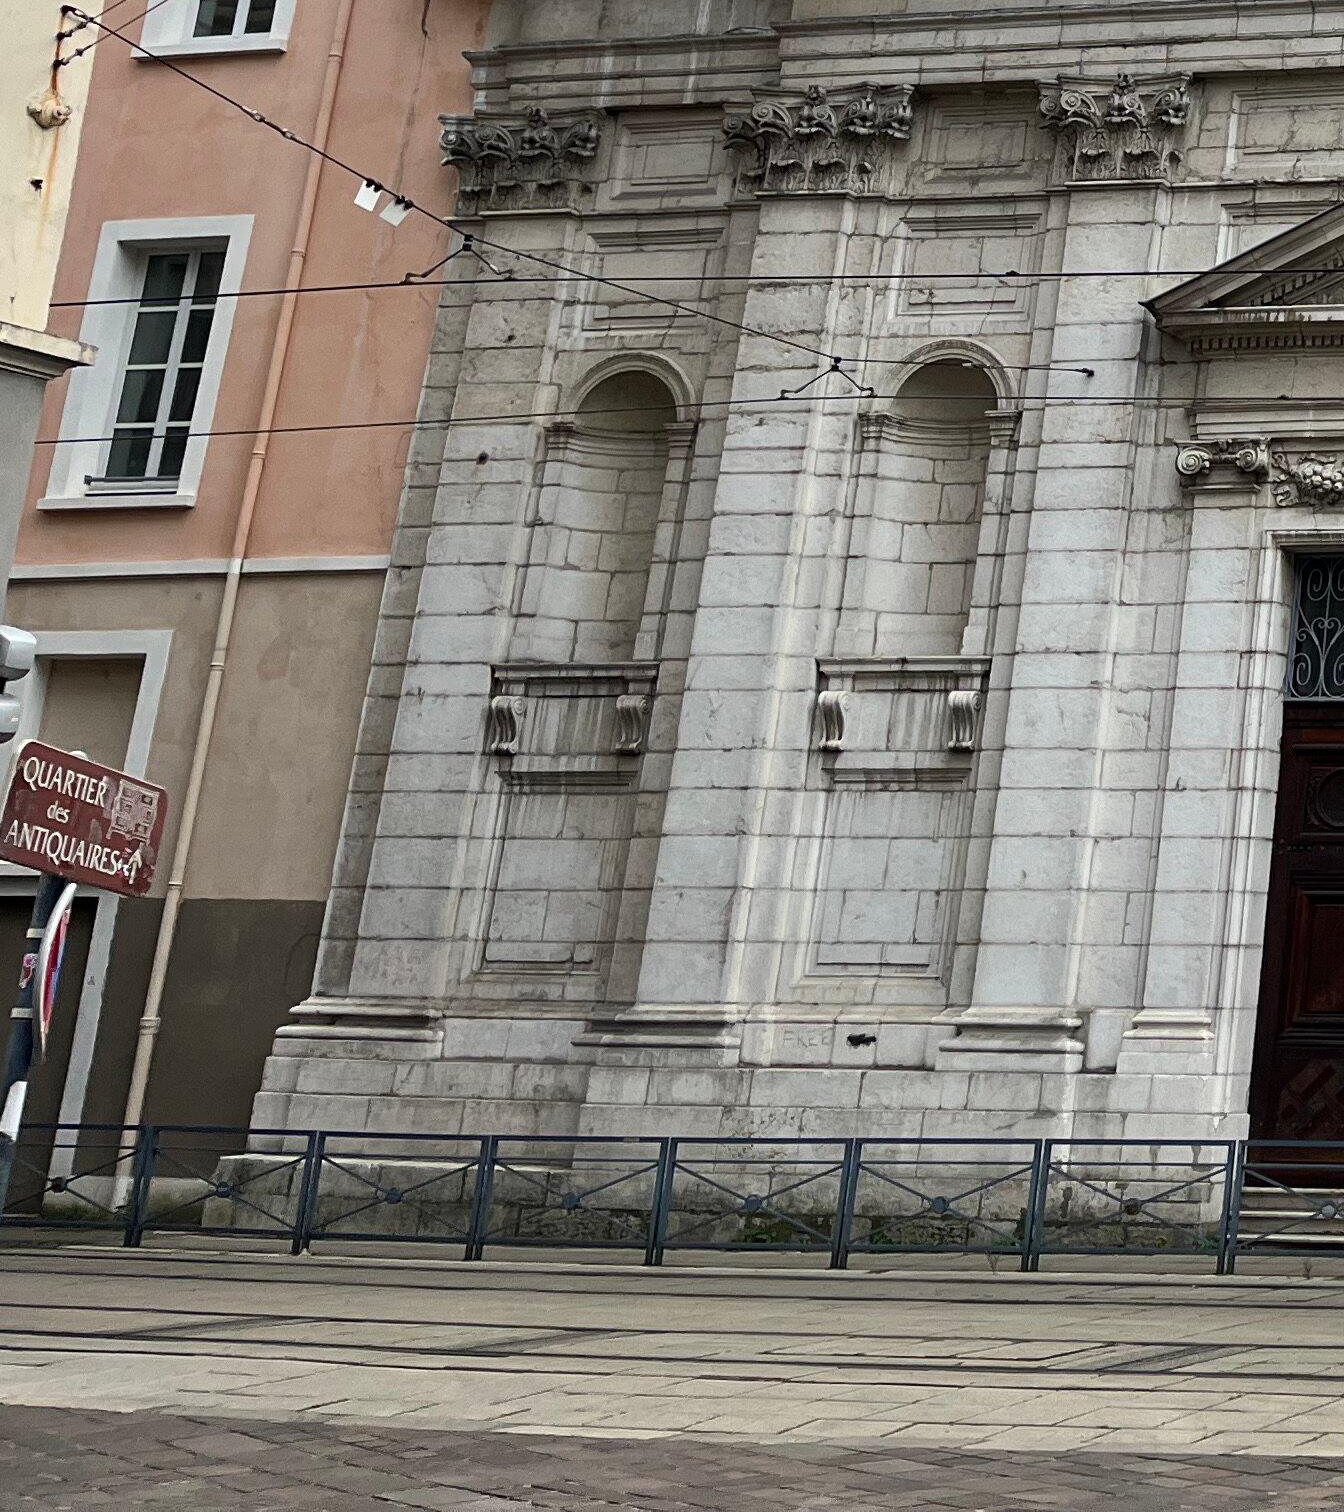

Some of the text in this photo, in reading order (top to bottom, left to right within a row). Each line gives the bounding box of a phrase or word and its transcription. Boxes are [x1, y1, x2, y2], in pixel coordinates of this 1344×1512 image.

[23, 756, 108, 808] QUARTIER
[46, 800, 71, 824] des
[3, 819, 120, 876] ANTIQUAIRES
